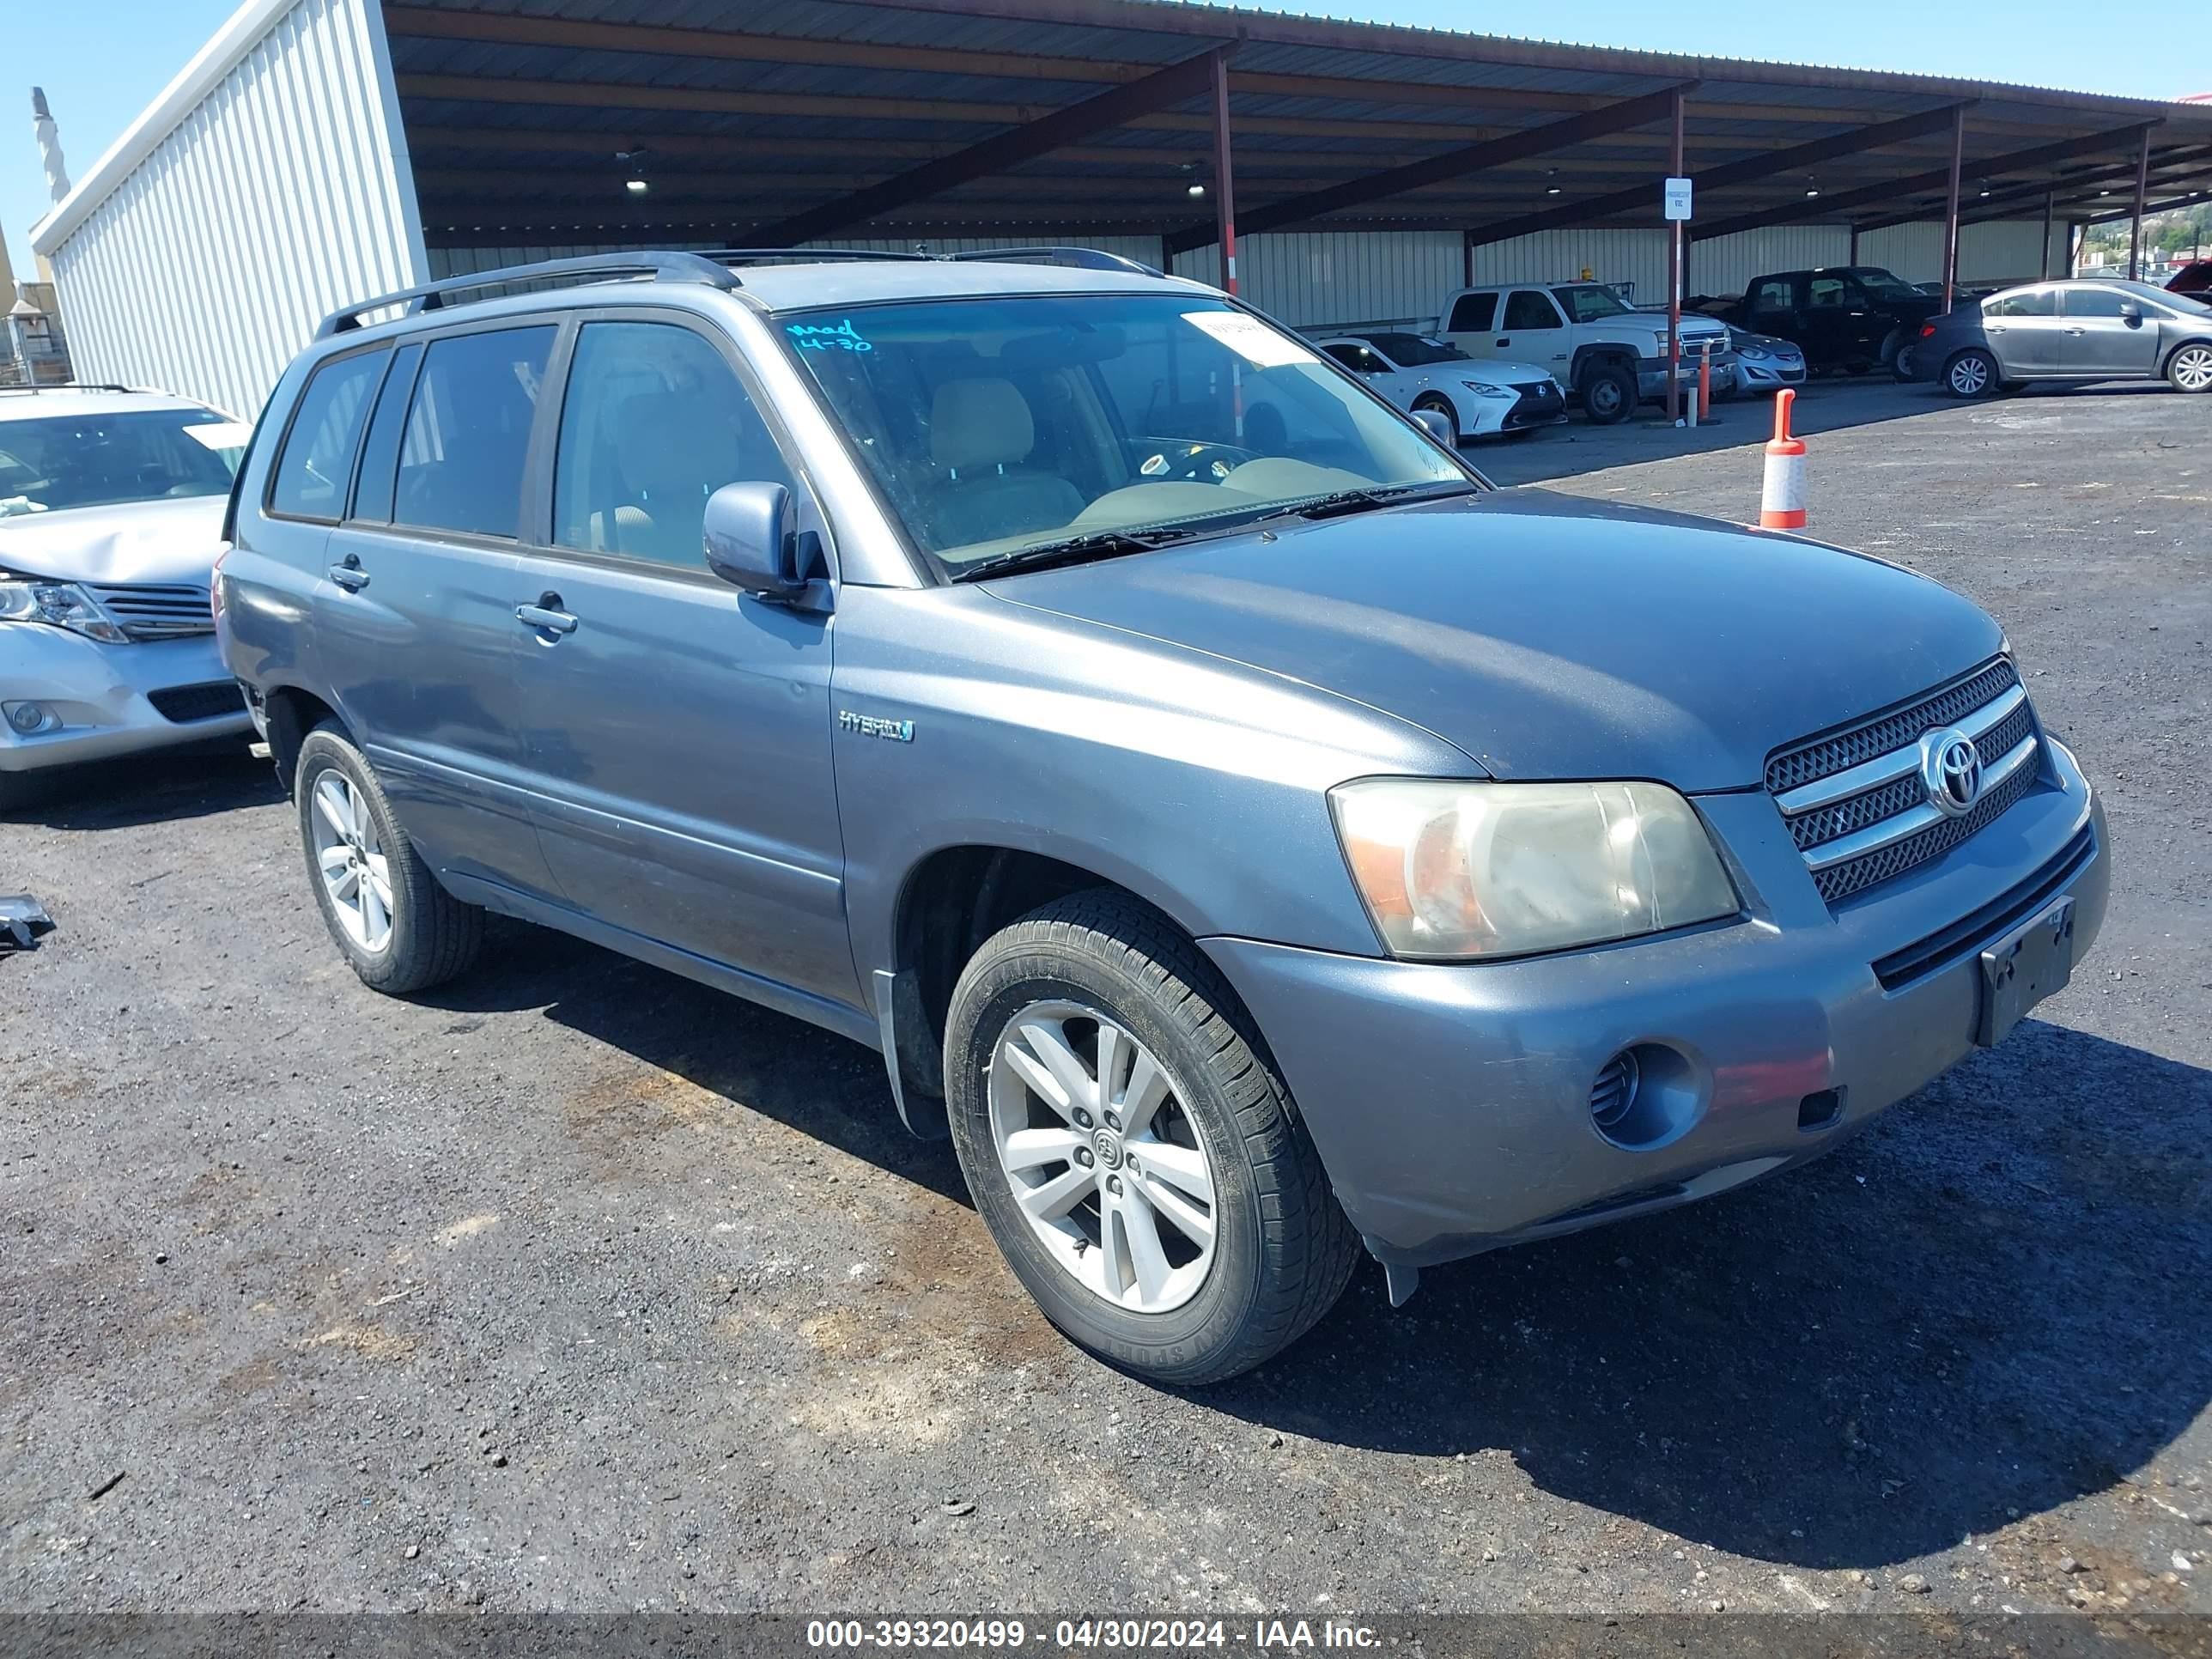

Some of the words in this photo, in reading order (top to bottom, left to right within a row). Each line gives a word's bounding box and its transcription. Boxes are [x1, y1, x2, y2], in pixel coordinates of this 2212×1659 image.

[800, 338, 872, 351] 4-30
[839, 710, 903, 739] HYBRID
[1103, 1338, 1185, 1365] SPORT
